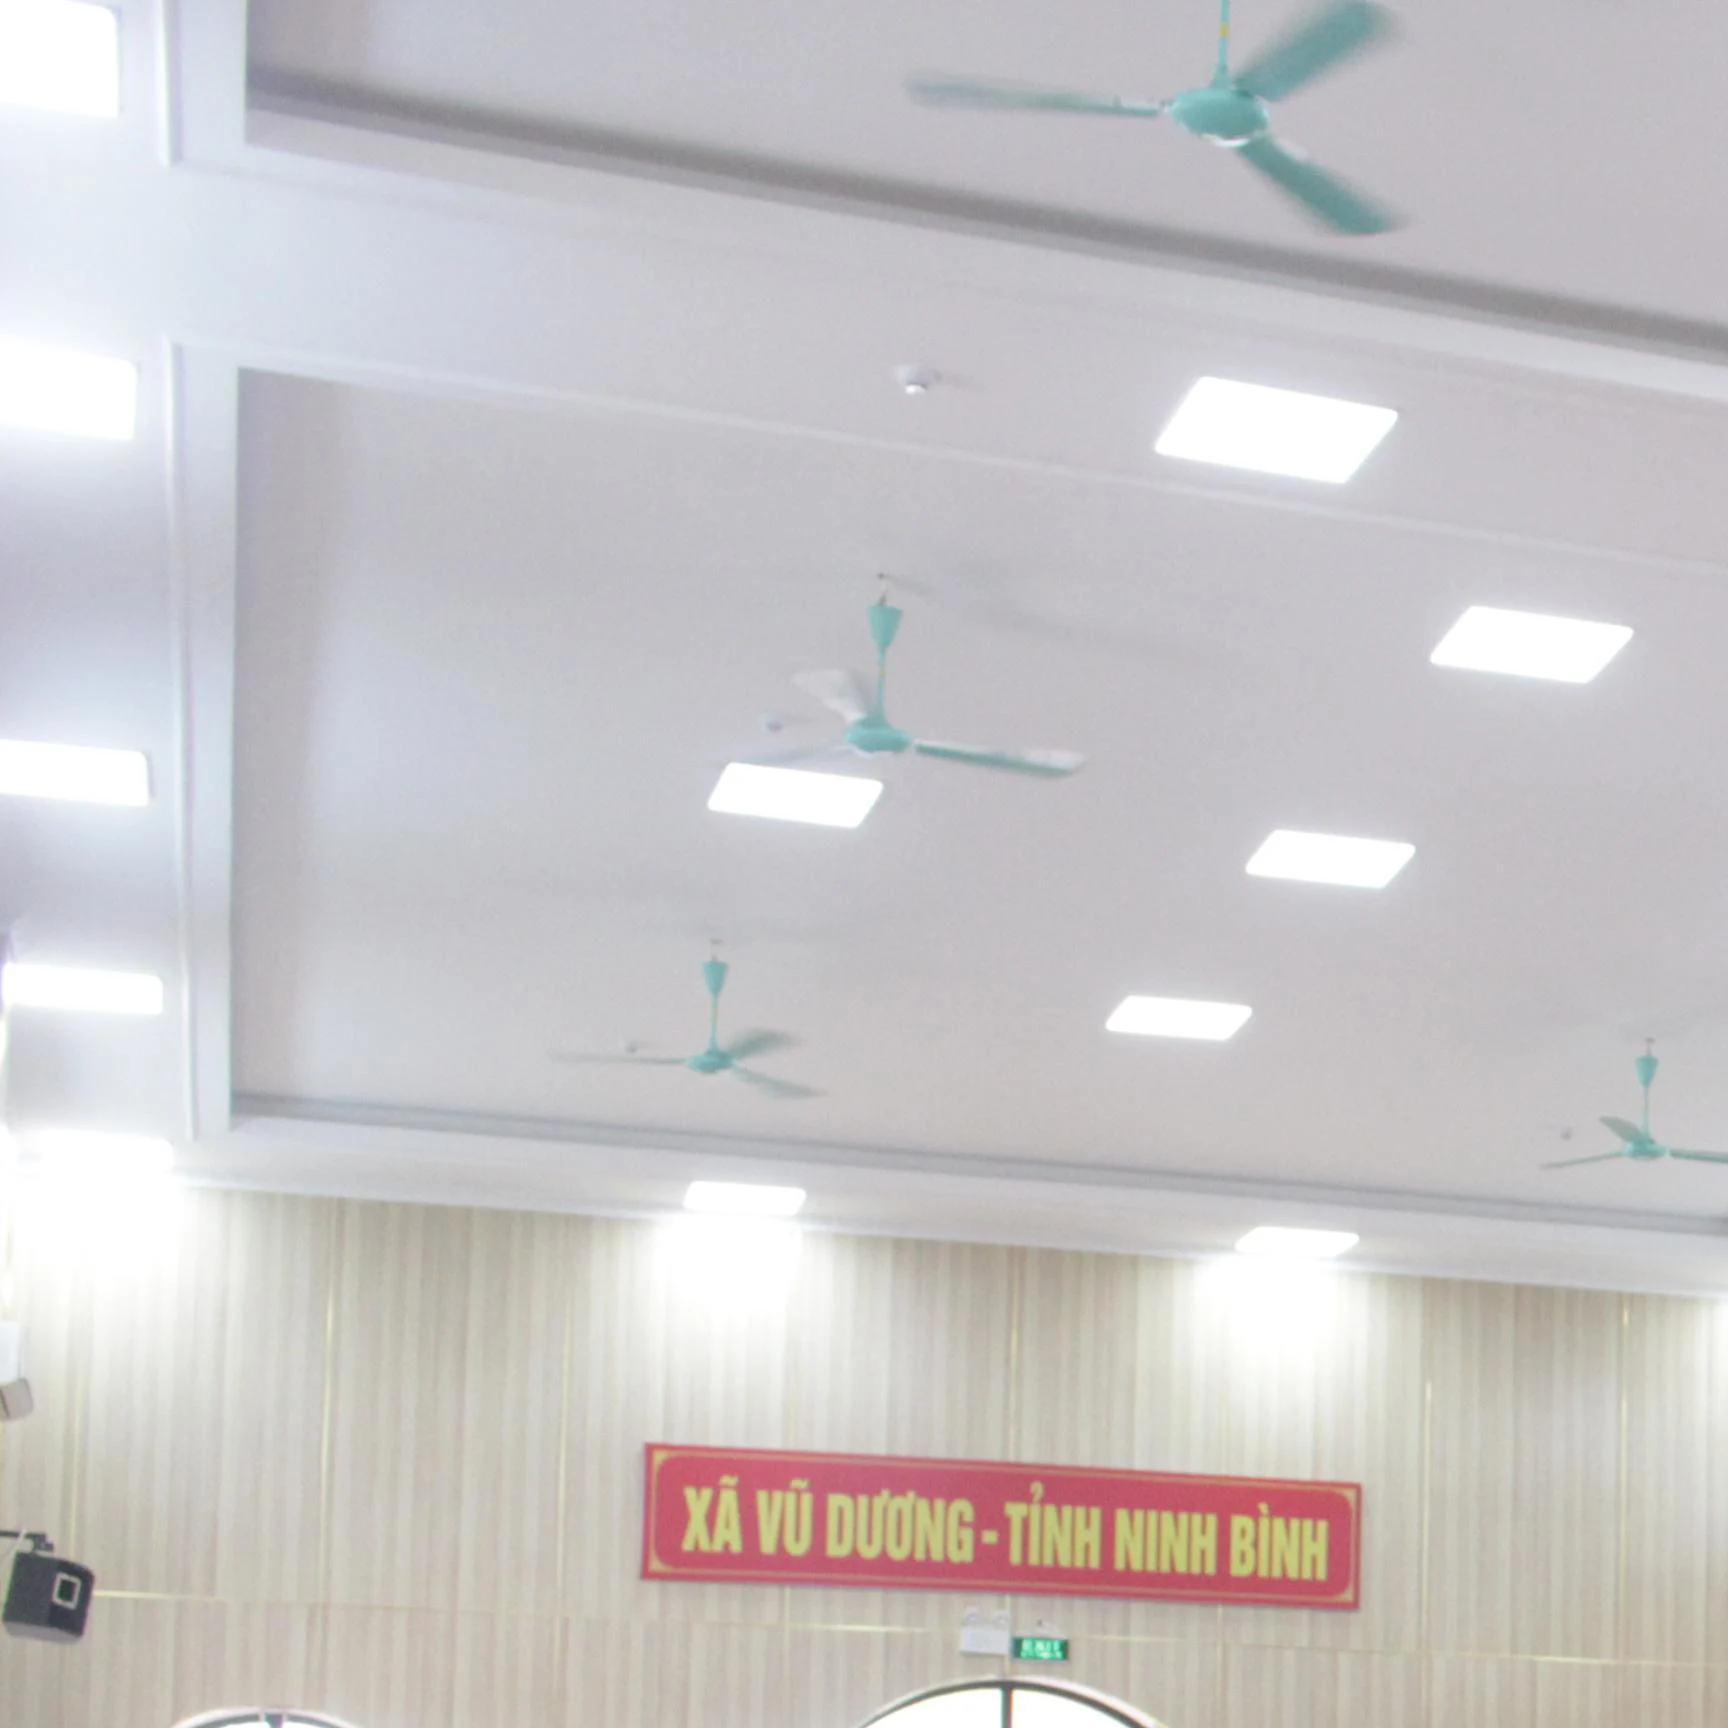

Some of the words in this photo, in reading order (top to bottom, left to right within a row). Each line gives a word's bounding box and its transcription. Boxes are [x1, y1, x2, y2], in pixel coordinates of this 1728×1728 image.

[682, 1476, 740, 1552] XÃ
[756, 1480, 810, 1556] VŨ
[826, 1488, 974, 1563] DƯƠNG
[1005, 1482, 1100, 1569] TỈNH
[1114, 1507, 1217, 1575] NINH
[1230, 1503, 1329, 1581] BÌNH
